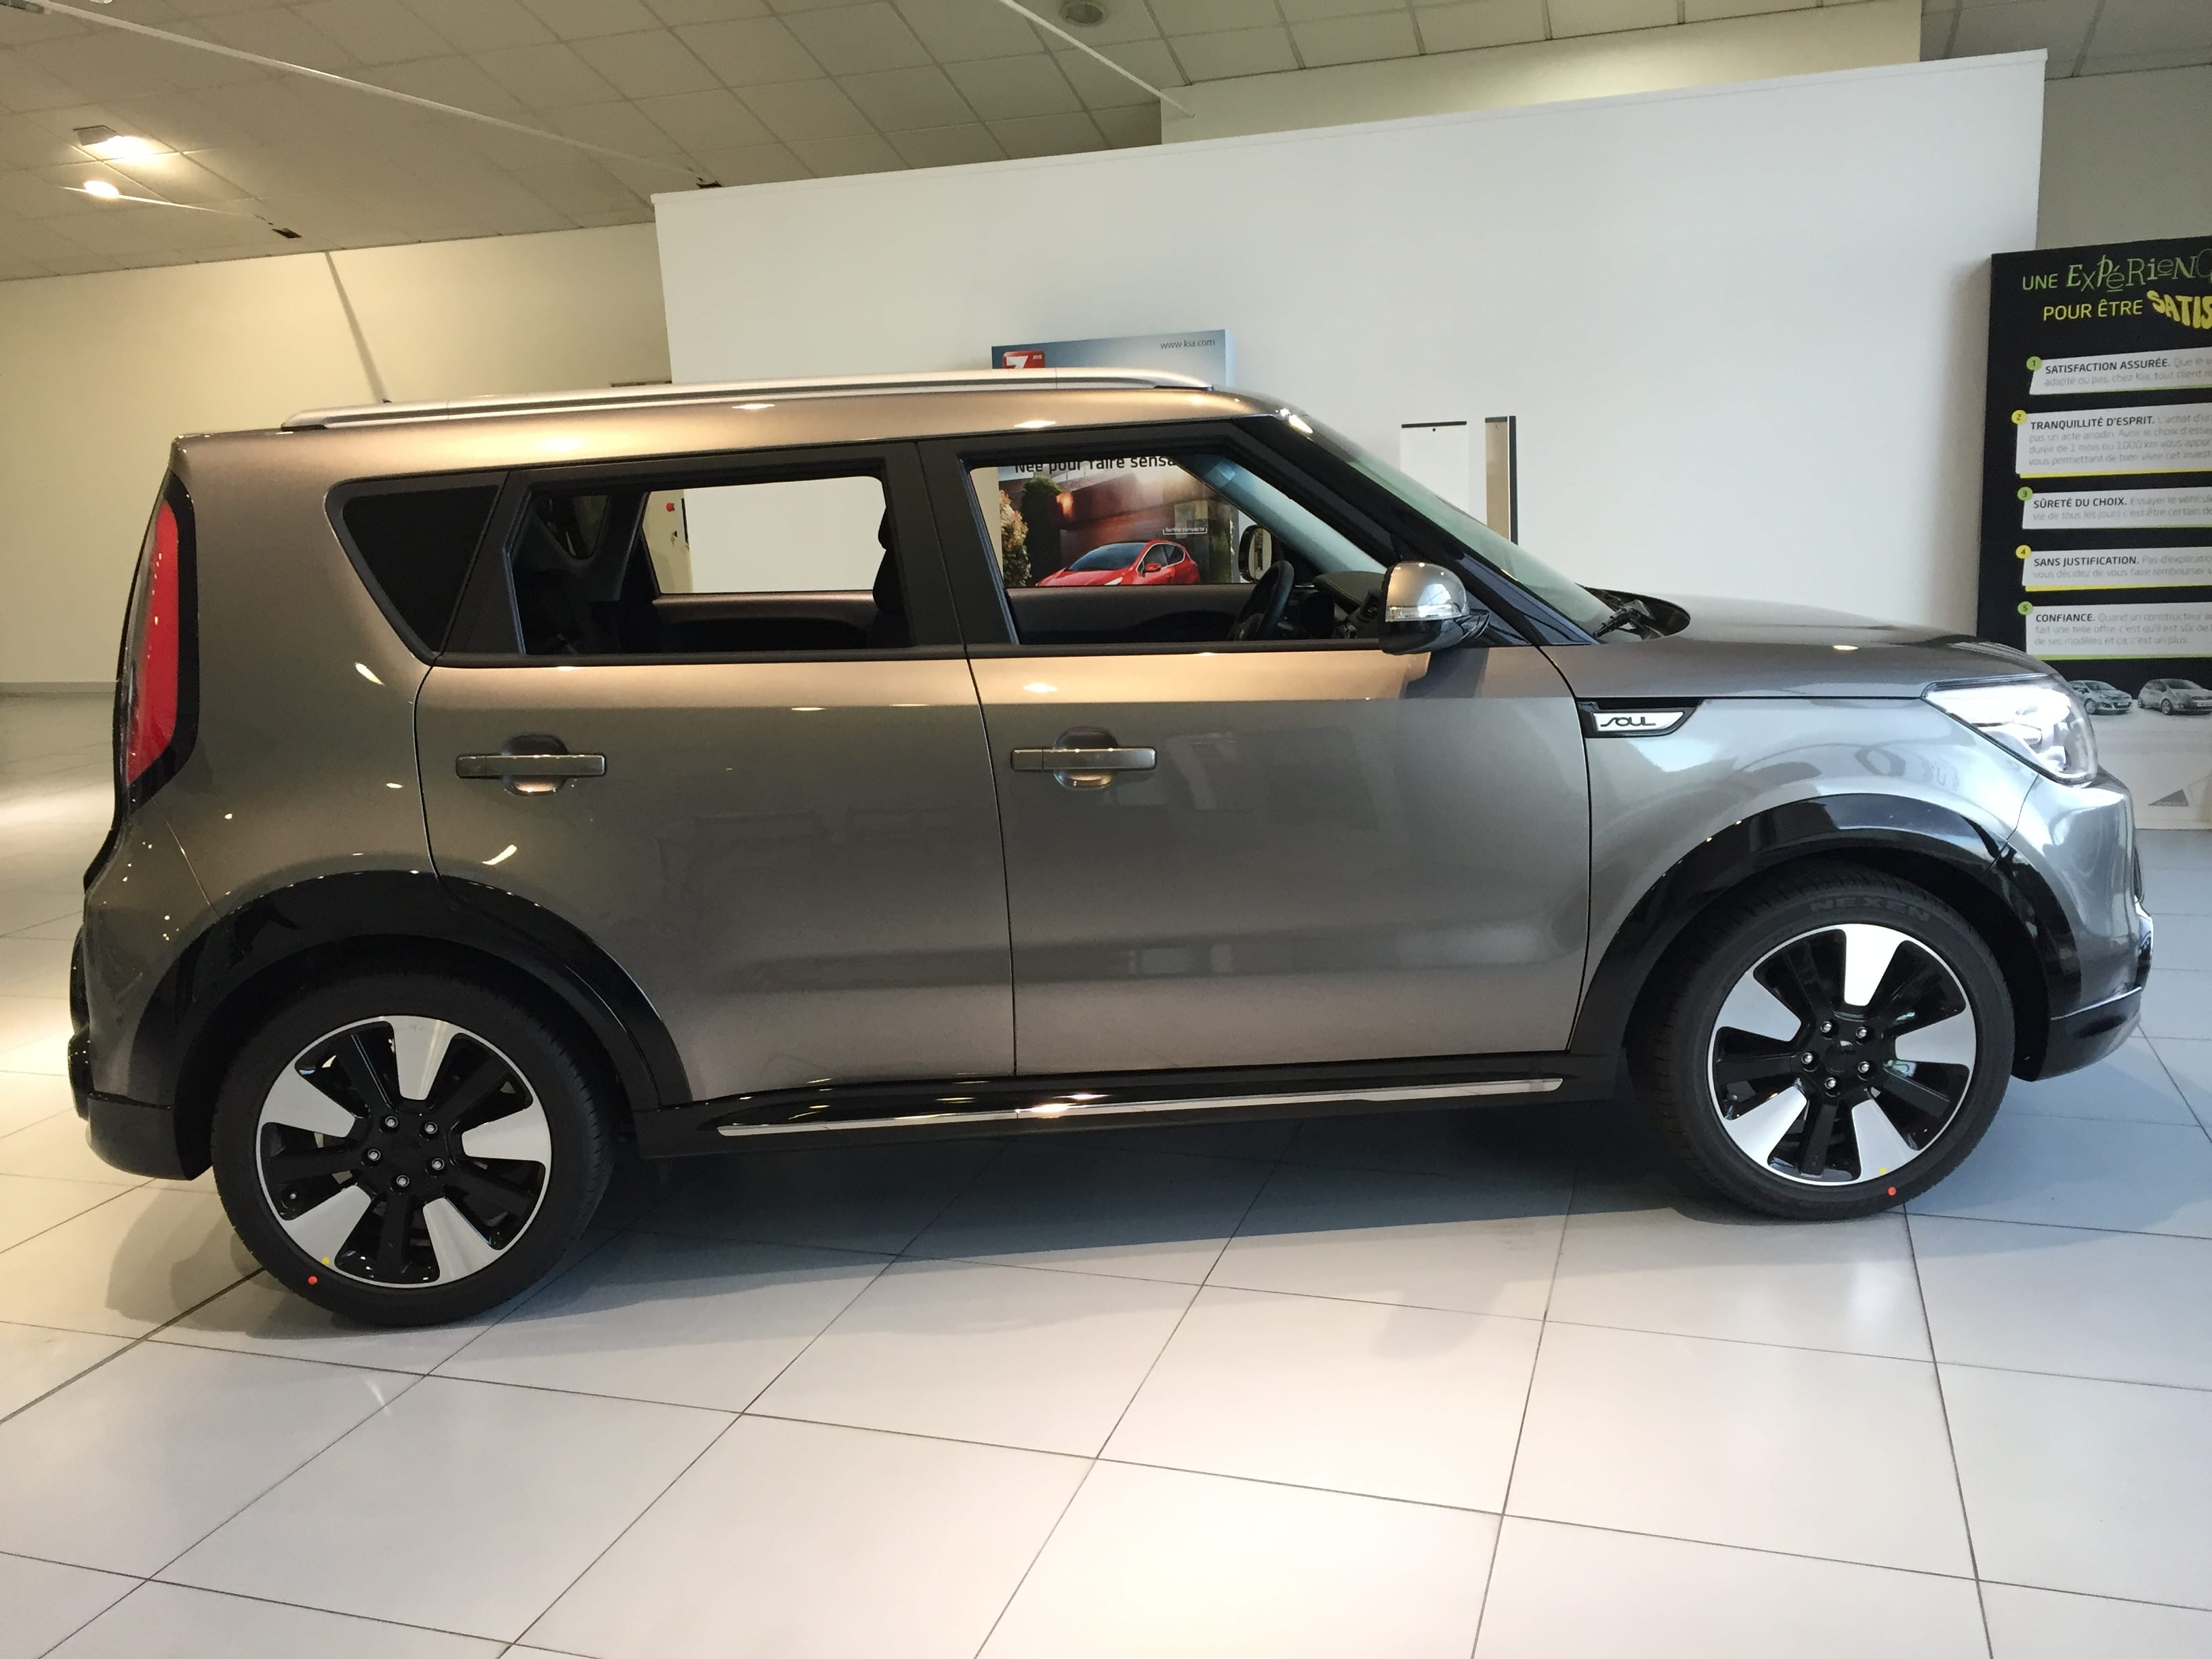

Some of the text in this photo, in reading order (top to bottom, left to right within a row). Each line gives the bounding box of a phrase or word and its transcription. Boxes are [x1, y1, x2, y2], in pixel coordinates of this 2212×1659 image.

[2022, 273, 2058, 291] UNE
[2043, 305, 2092, 321] POUR
[2098, 298, 2143, 317] ÊTRE
[1160, 340, 1215, 349] www.kia.com
[2045, 362, 2117, 374] SATISFACTION
[2120, 356, 2171, 369] ASSURÉE.
[2030, 417, 2104, 430] TRANQUILLITÉ
[2106, 415, 2155, 427] D'ESPRIT.
[2052, 455, 2103, 466] permettant
[1048, 461, 1080, 474] pour
[2033, 497, 2072, 508] SÛRETÉ
[2075, 499, 2089, 507] DU
[2093, 497, 2127, 506] CHOIX.
[2084, 510, 2096, 518] les
[2034, 558, 2061, 567] SANS
[2062, 556, 2139, 567] JUSTIFICATION.
[2093, 569, 2104, 577] de
[2036, 613, 2095, 622] CONFIANCE.
[1600, 716, 1656, 727] SOUL
[1809, 897, 1930, 922] NEXEN
